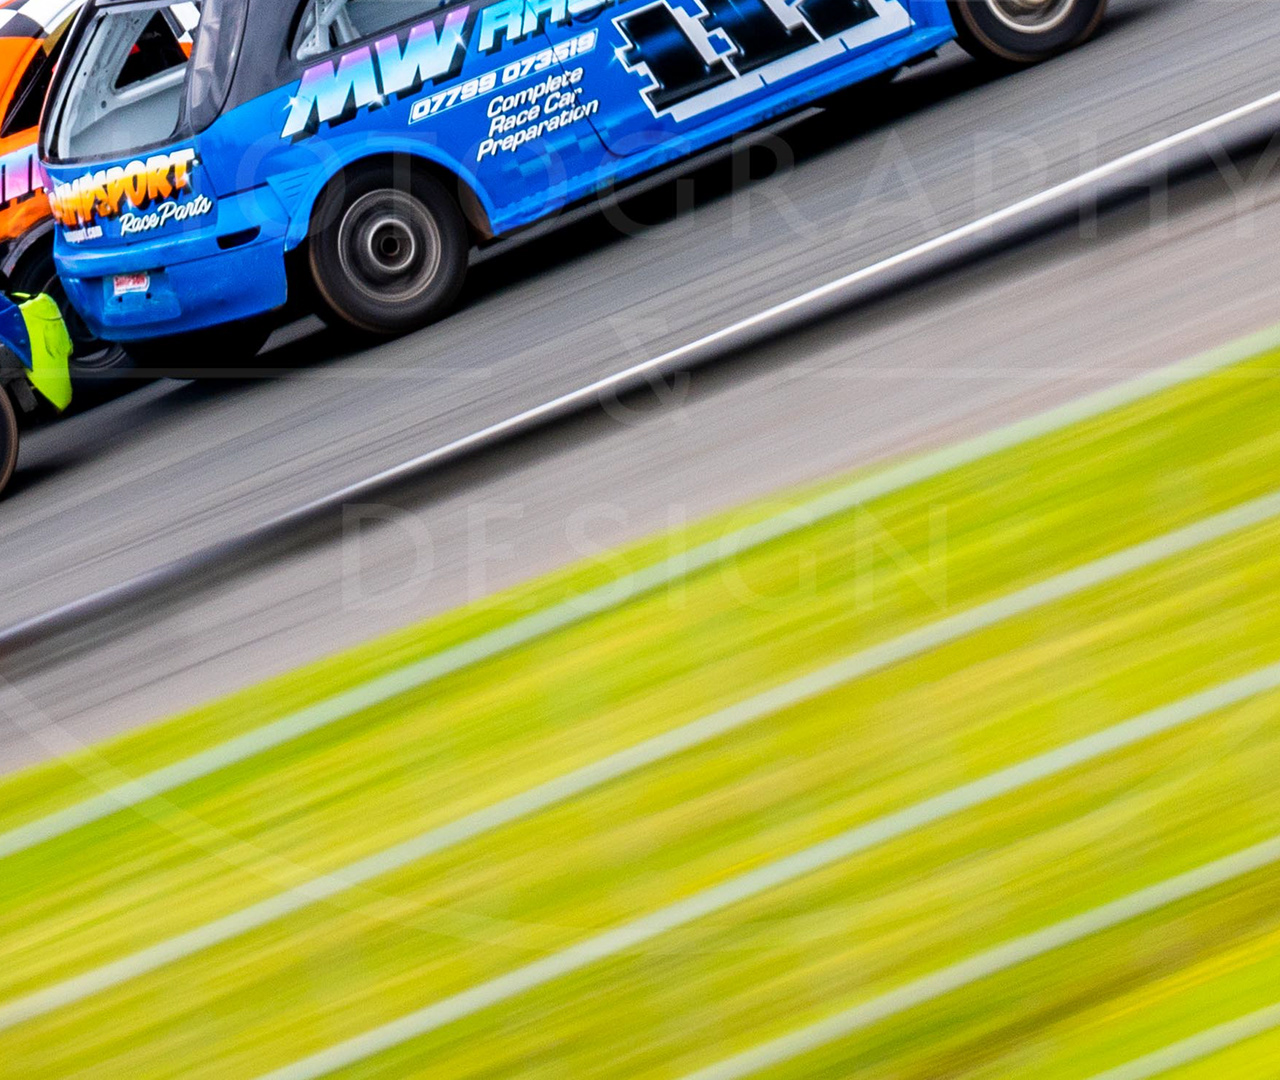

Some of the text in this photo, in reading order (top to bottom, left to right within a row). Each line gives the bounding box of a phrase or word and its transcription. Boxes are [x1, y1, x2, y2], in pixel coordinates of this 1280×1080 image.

[280, 5, 471, 140] MW
[412, 69, 496, 120] 07799
[486, 66, 584, 119] Complete
[475, 99, 599, 163] Preparation
[488, 88, 582, 138] Race Car
[119, 193, 213, 237] Race Parts
